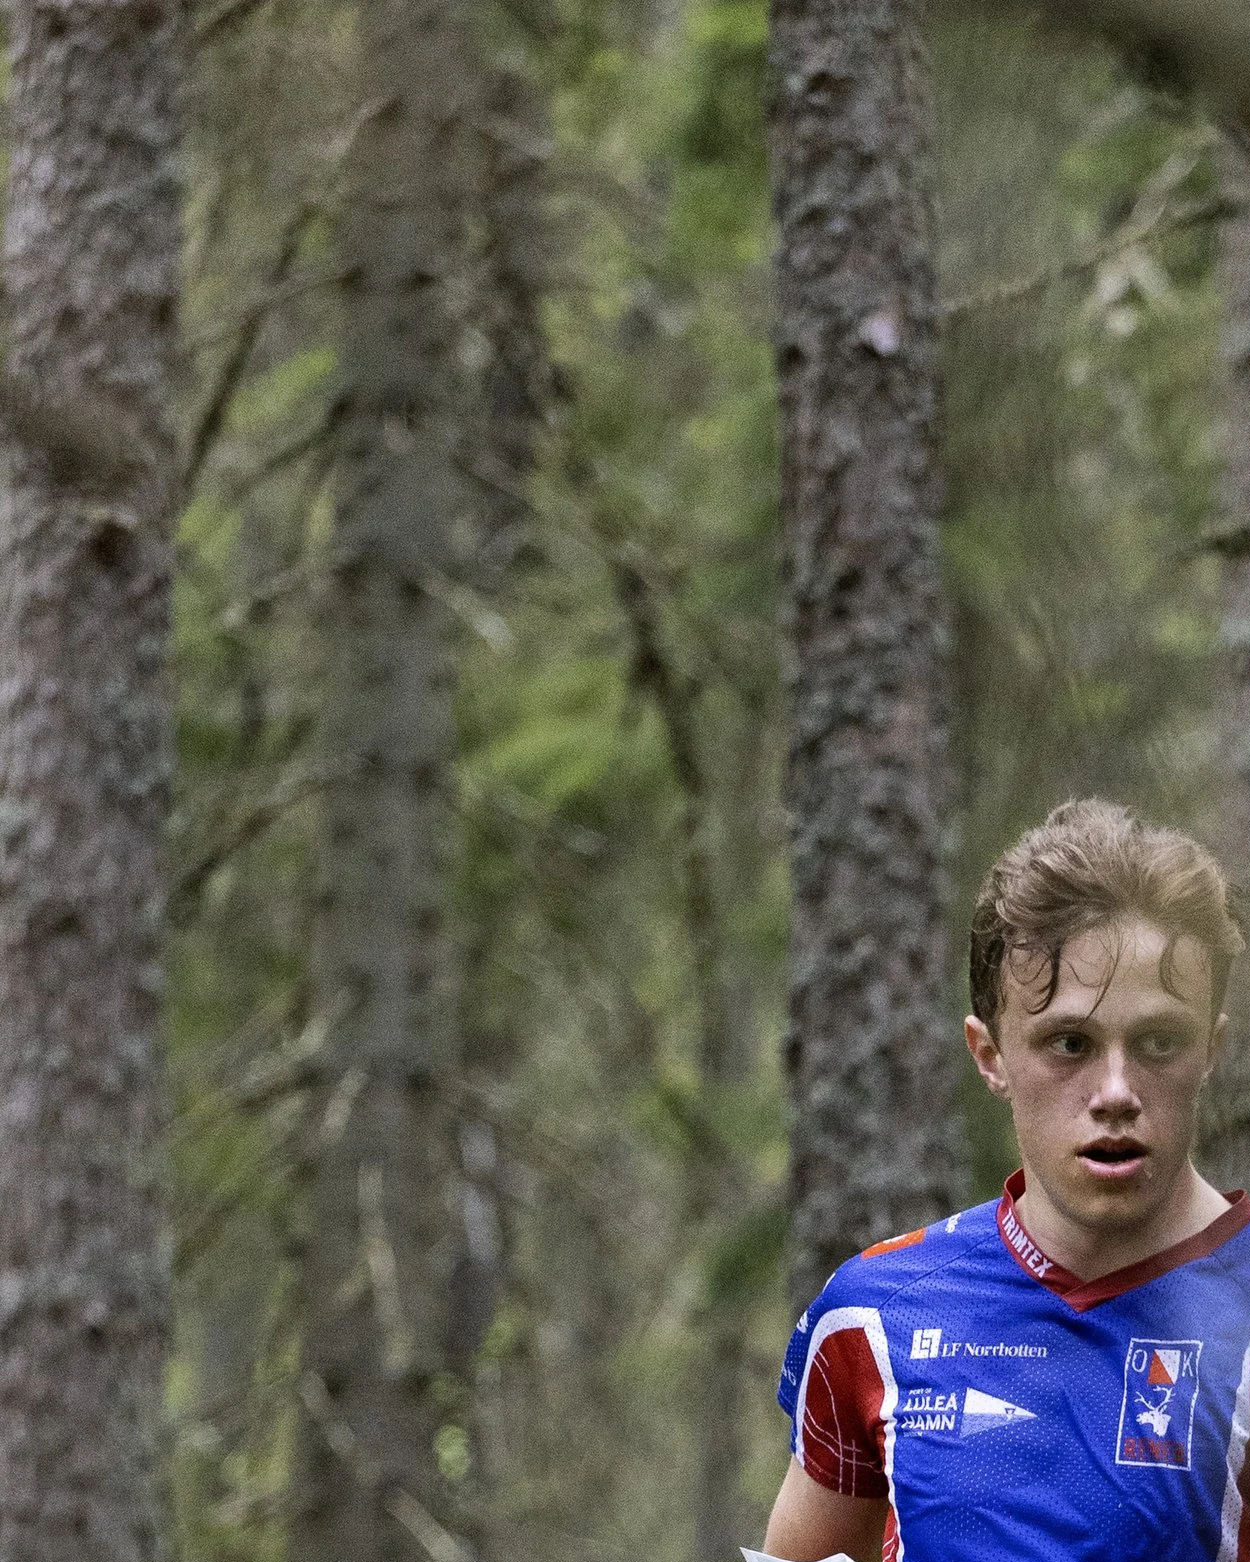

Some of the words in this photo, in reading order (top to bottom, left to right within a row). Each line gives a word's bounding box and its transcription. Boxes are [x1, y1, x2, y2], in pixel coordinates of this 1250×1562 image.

[1002, 1208, 1053, 1279] TRIMTEX
[941, 1343, 961, 1358] LF
[963, 1342, 1048, 1359] Norrbotten
[1131, 1349, 1148, 1373] O
[1182, 1351, 1194, 1378] K
[902, 1392, 958, 1412] LULEÅ
[901, 1413, 956, 1431] HAMN
